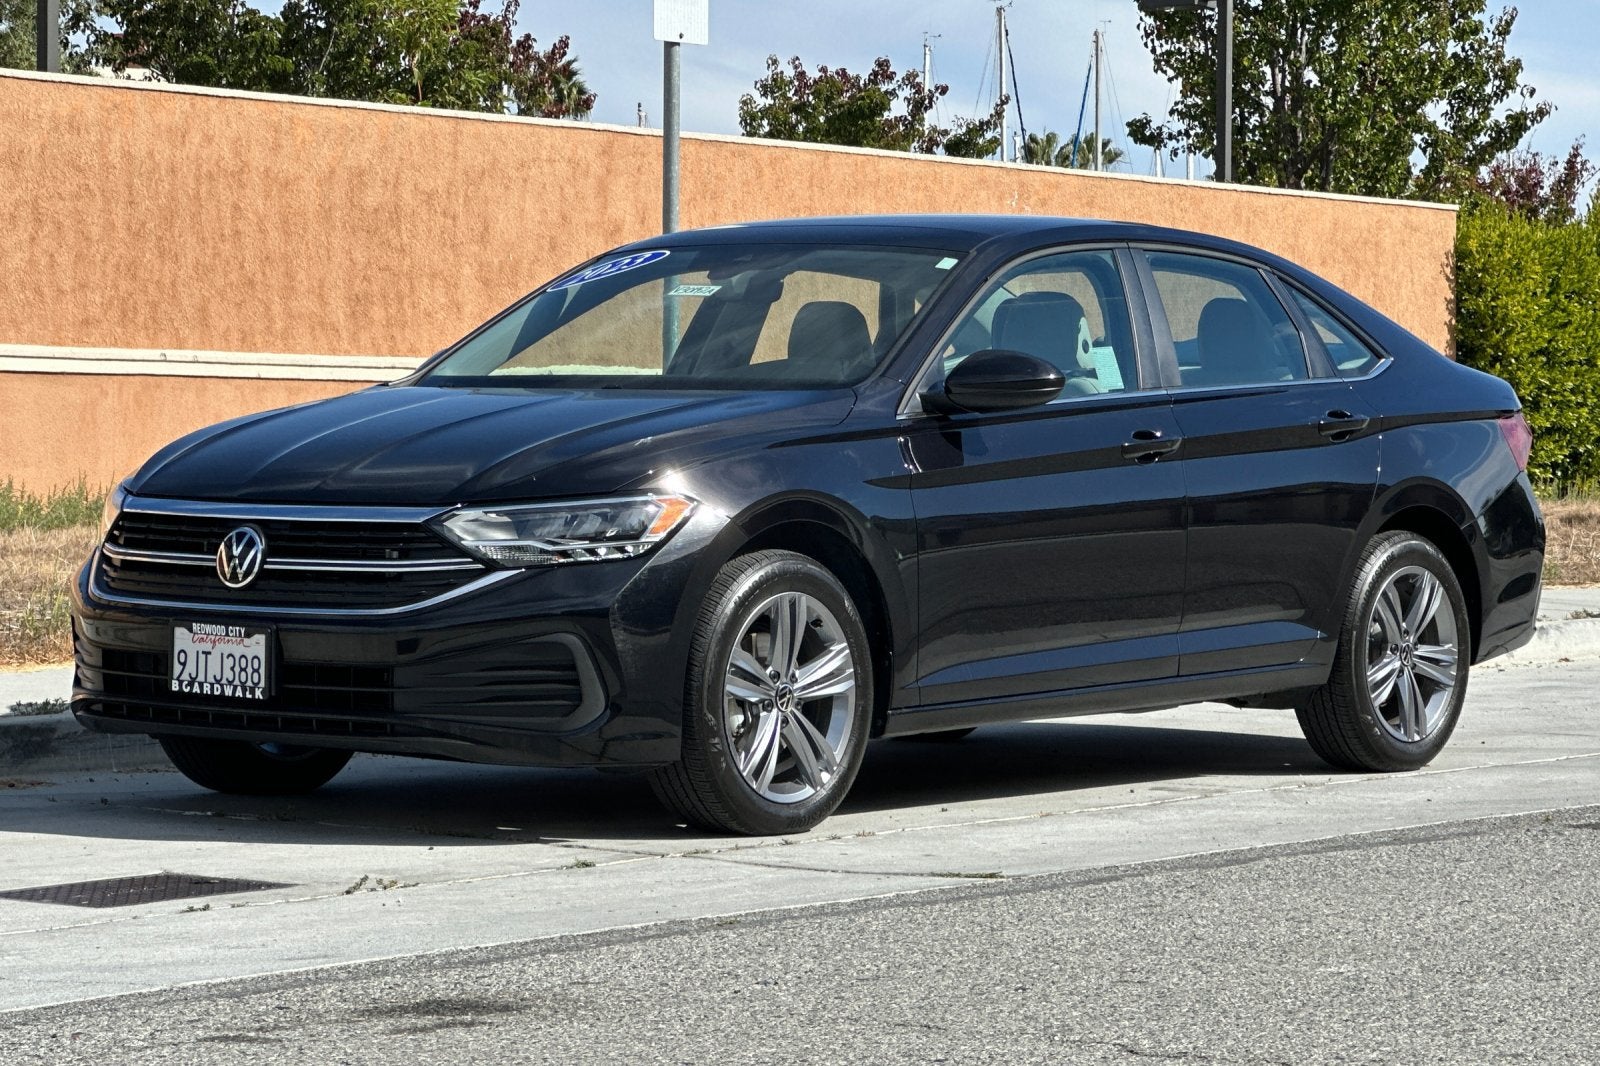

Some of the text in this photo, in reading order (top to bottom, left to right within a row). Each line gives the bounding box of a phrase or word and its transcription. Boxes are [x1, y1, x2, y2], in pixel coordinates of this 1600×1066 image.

[192, 622, 246, 638] REDWOOD CITY
[192, 634, 250, 650] California
[176, 648, 262, 687] 9JTJ388
[171, 679, 264, 700] BOARDWALK
